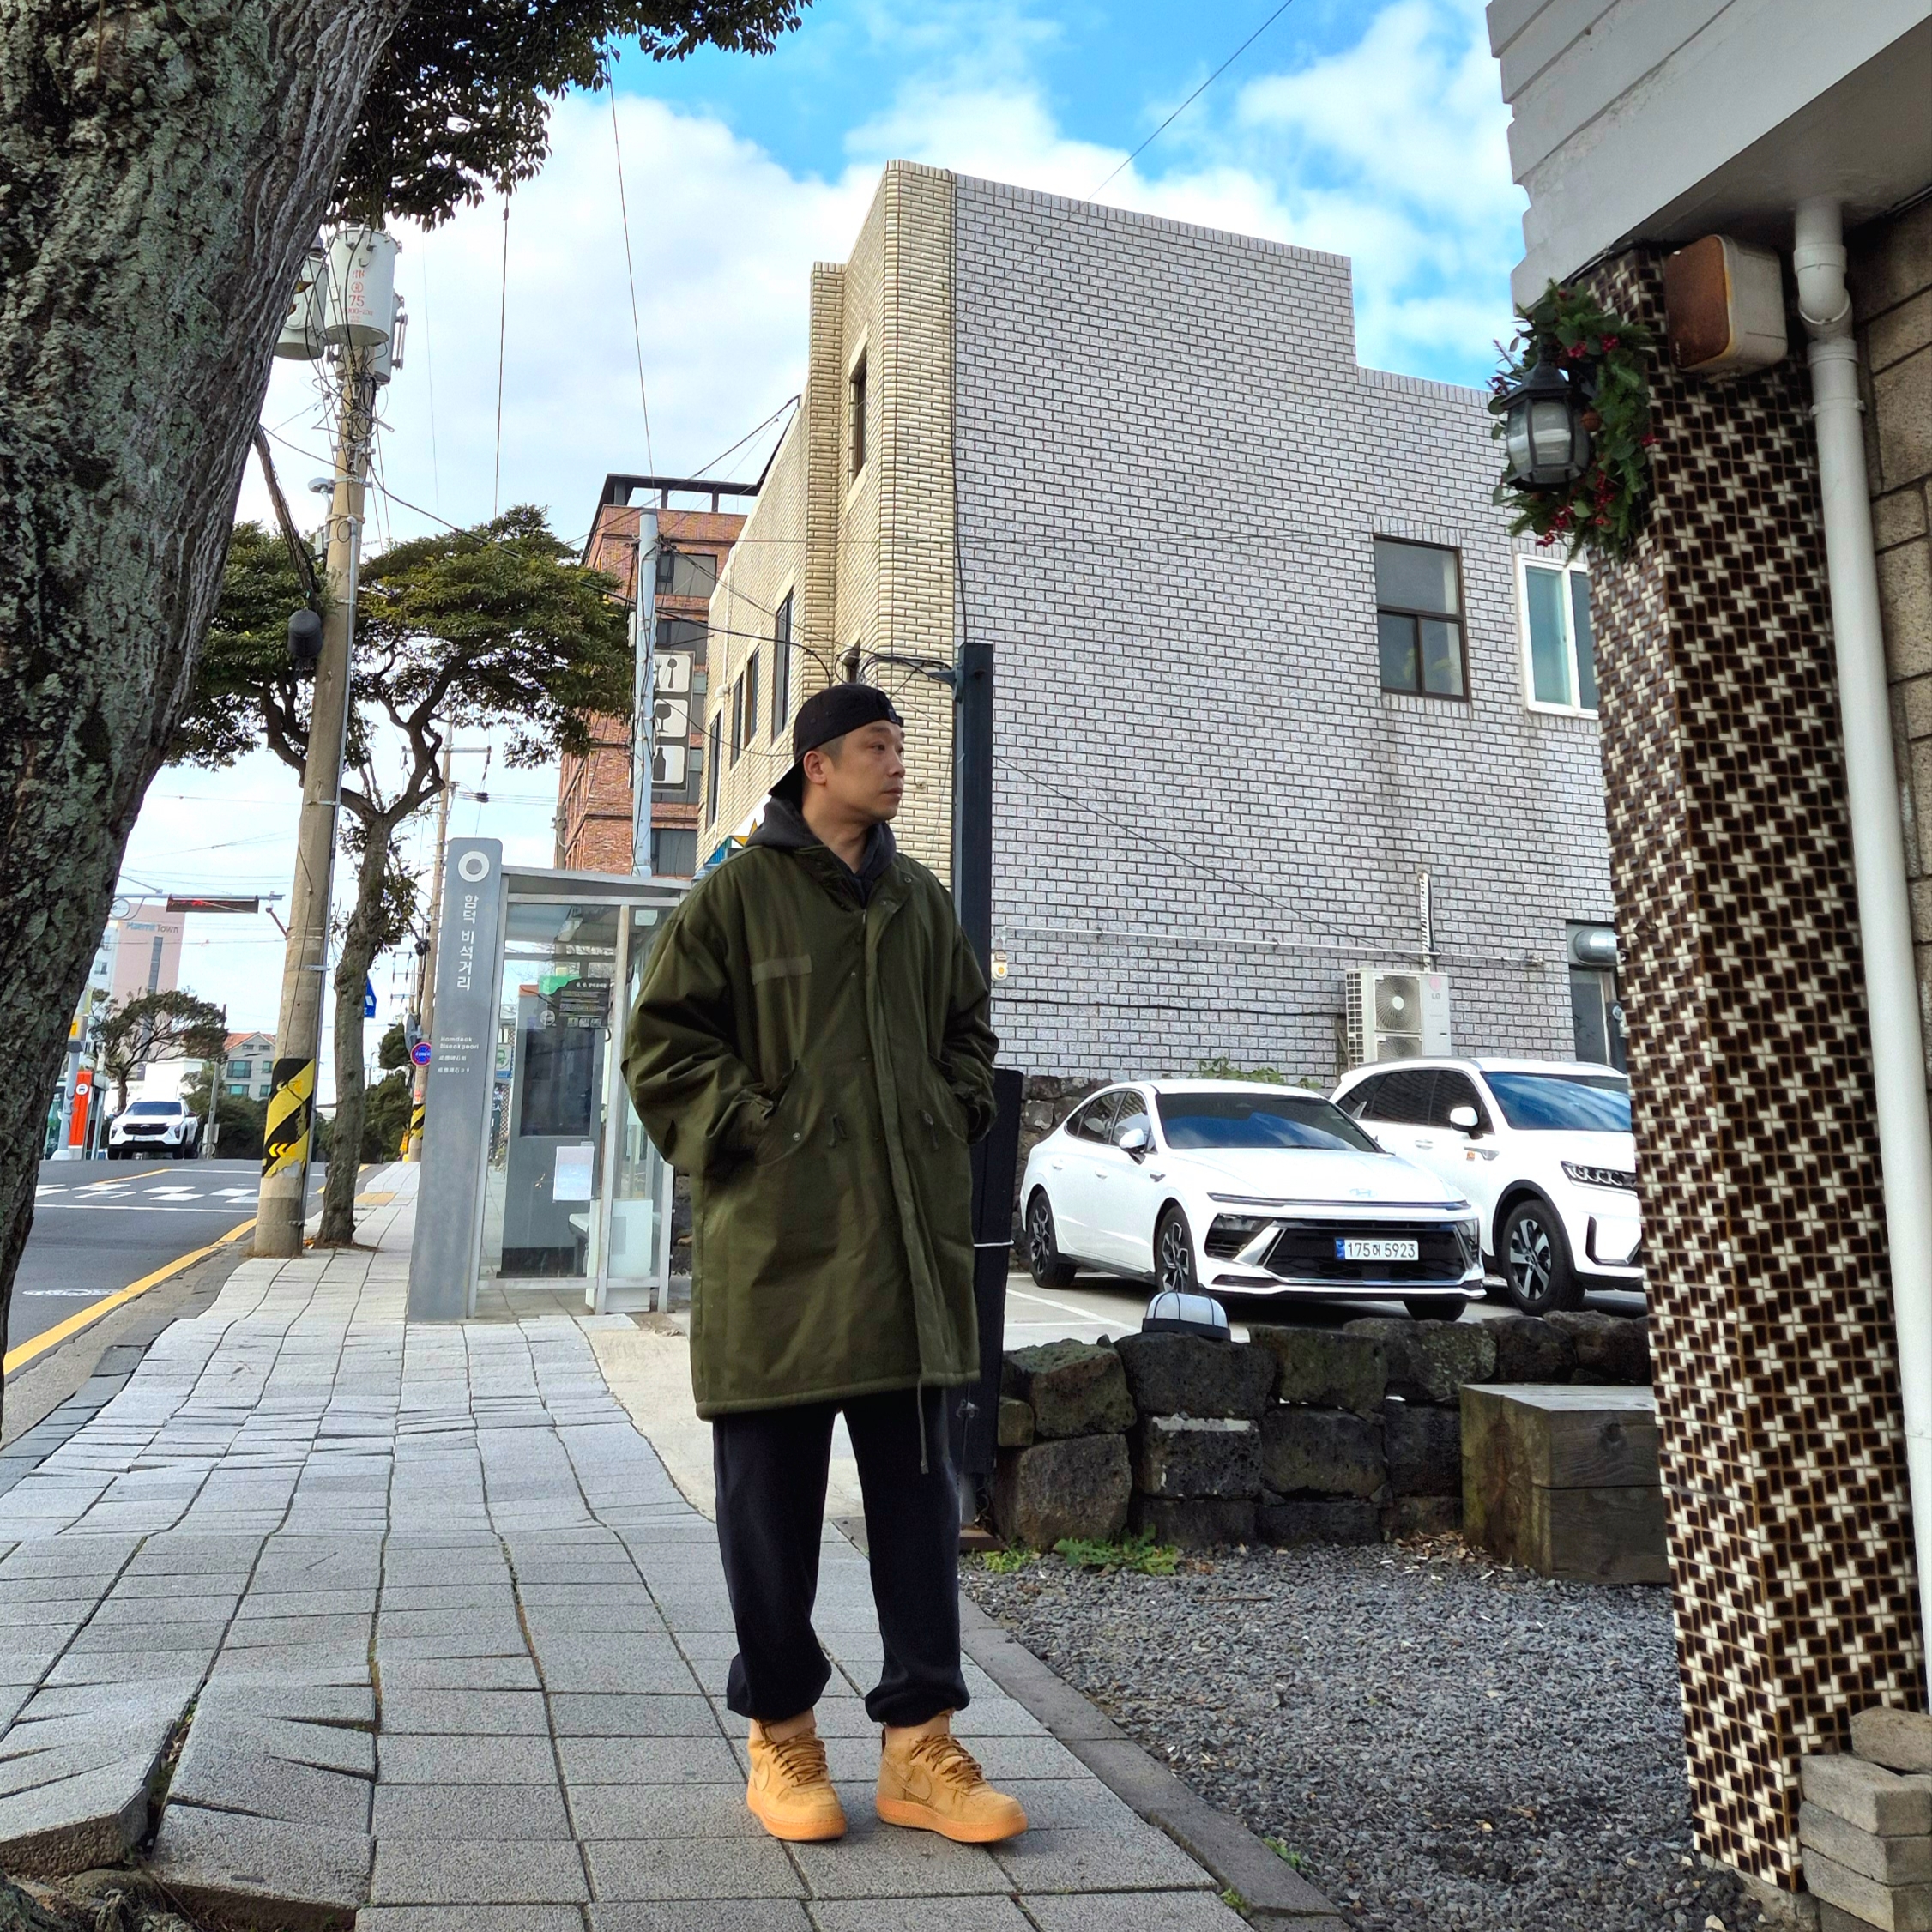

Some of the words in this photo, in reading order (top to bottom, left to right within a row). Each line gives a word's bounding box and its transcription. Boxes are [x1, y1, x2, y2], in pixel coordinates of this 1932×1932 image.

[348, 295, 365, 306] 75
[463, 894, 480, 925] 함덕
[157, 924, 179, 933] Town
[456, 930, 474, 991] 비석거리
[1385, 1242, 1416, 1258] 5923
